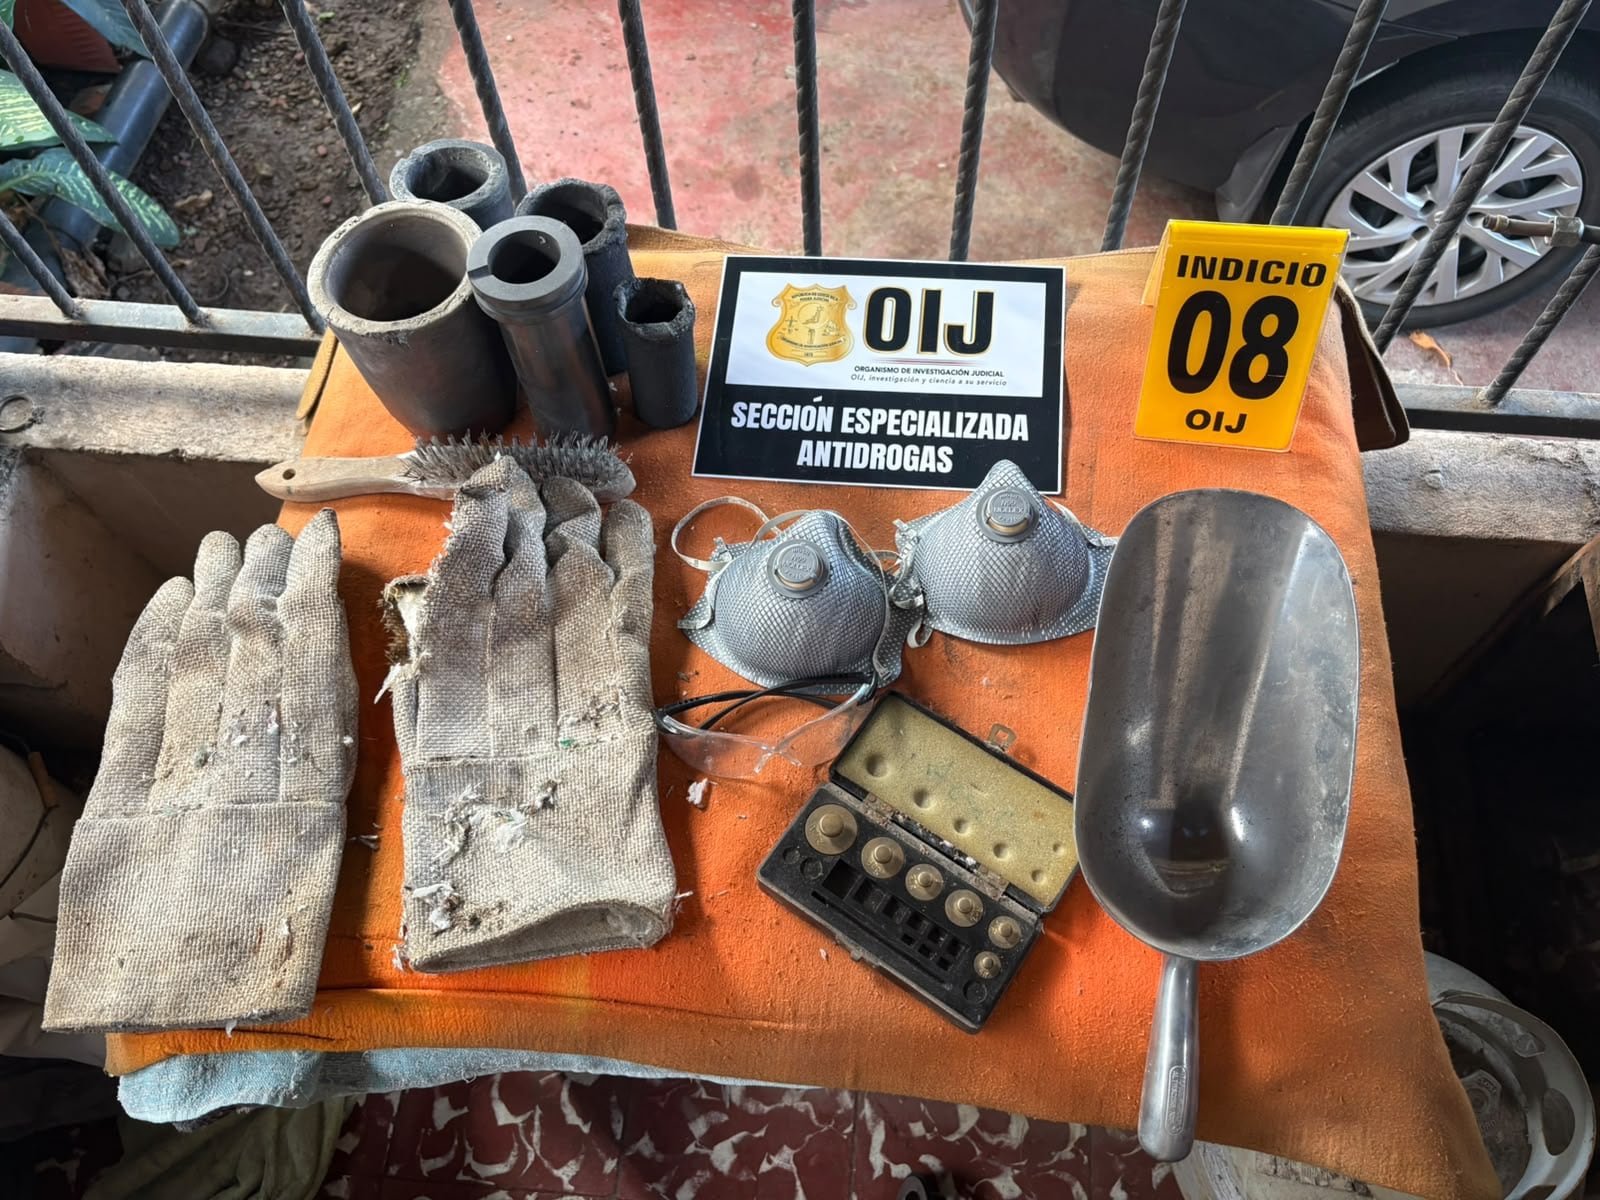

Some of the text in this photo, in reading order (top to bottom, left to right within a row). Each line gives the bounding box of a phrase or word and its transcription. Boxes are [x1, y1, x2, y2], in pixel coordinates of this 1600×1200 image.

[1177, 254, 1327, 287] INDICIO
[863, 287, 995, 356] OIJ
[1168, 290, 1299, 400] 08
[851, 373, 866, 382] OIJ,
[869, 374, 919, 383] investigación
[976, 379, 1007, 387] servicio
[854, 365, 899, 374] ORGANISMO
[913, 367, 969, 376] INVESTIGACIÓN
[971, 369, 1004, 378] JUDICIAL
[731, 395, 1029, 442] SECCIÓN ESPECIALIZADA
[1186, 409, 1247, 434] OIJ
[797, 439, 954, 474] ANTIDROGAS
